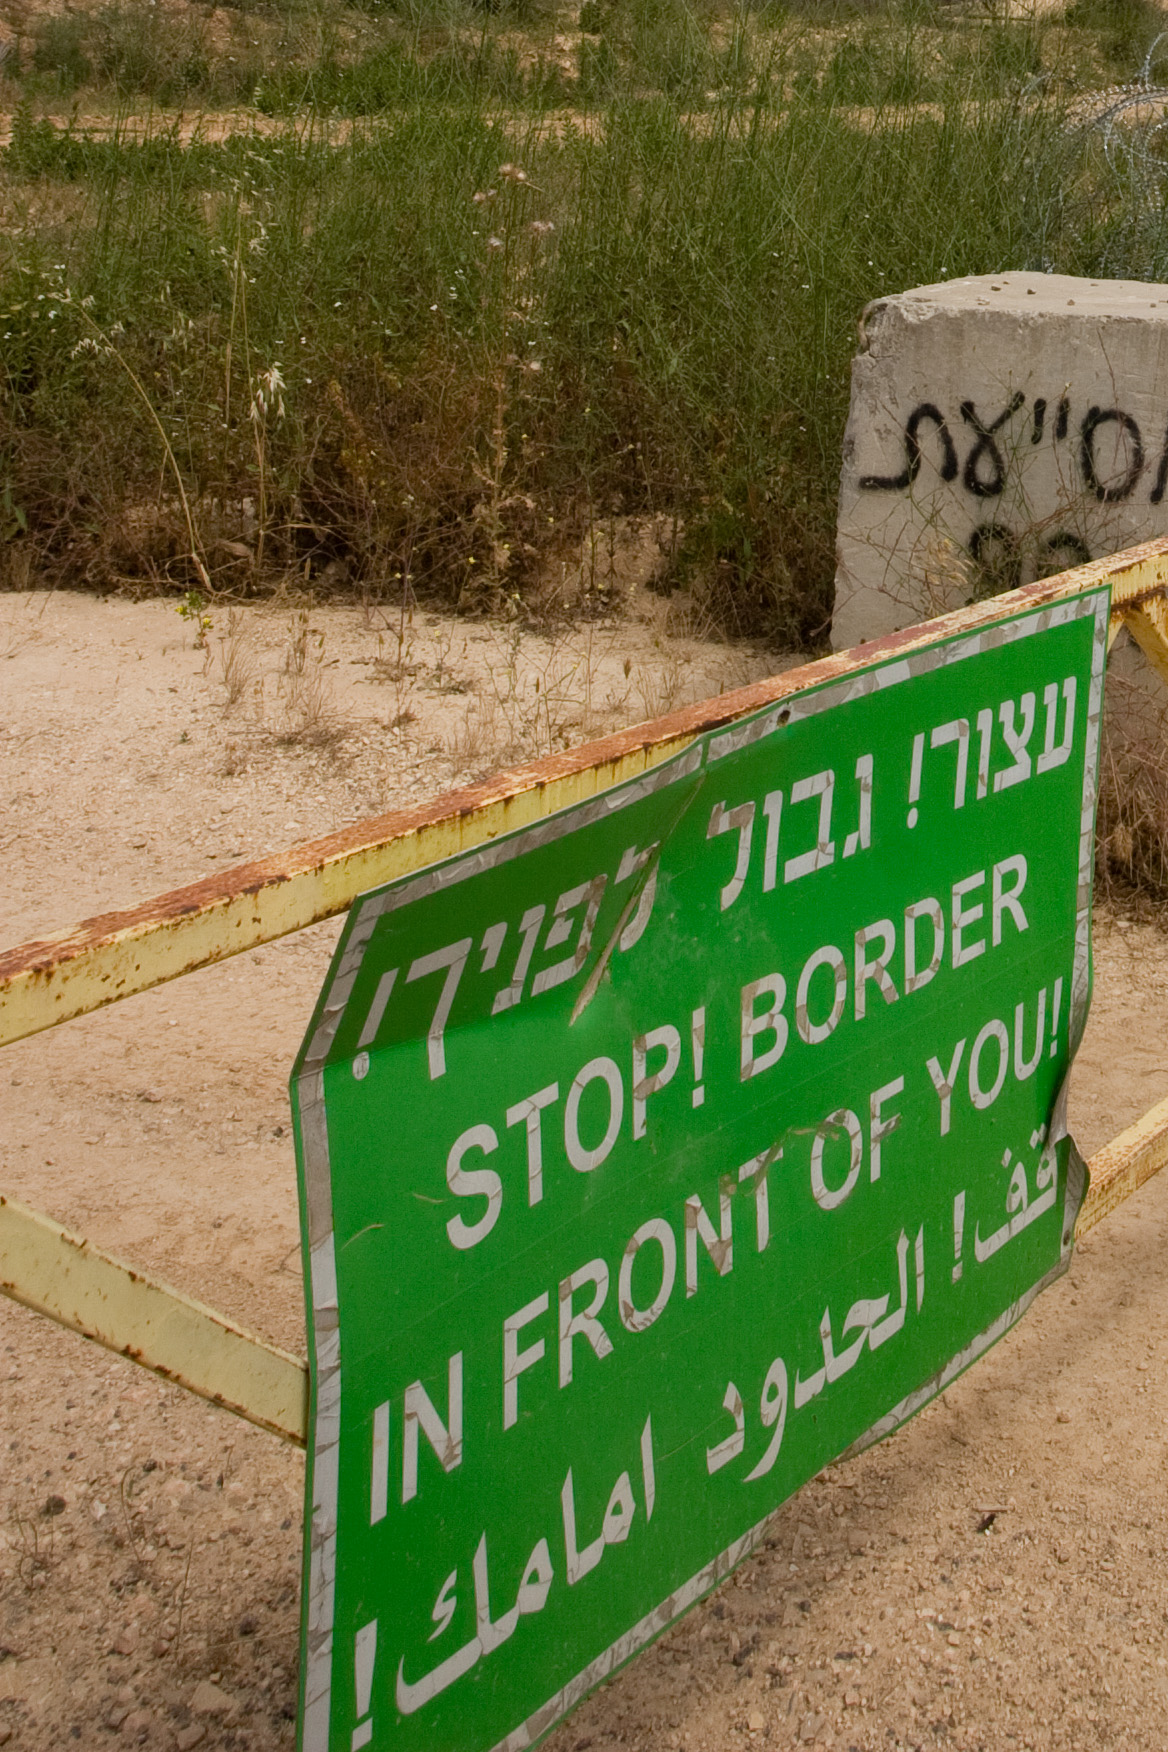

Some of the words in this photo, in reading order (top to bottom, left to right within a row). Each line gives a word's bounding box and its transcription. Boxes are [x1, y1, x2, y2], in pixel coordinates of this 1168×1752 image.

[706, 753, 873, 912] גבול
[906, 676, 1077, 829] עצור!
[352, 841, 661, 1081] לפניך!
[446, 1006, 705, 1249] STOP!
[740, 853, 1030, 1082] BORDER
[370, 1351, 463, 1527] IN
[503, 1149, 784, 1431] FRONT
[811, 1075, 904, 1210] OF
[925, 976, 1064, 1137] YOU!
[951, 1122, 1058, 1285] قف!
[706, 1222, 925, 1483] الحدود
